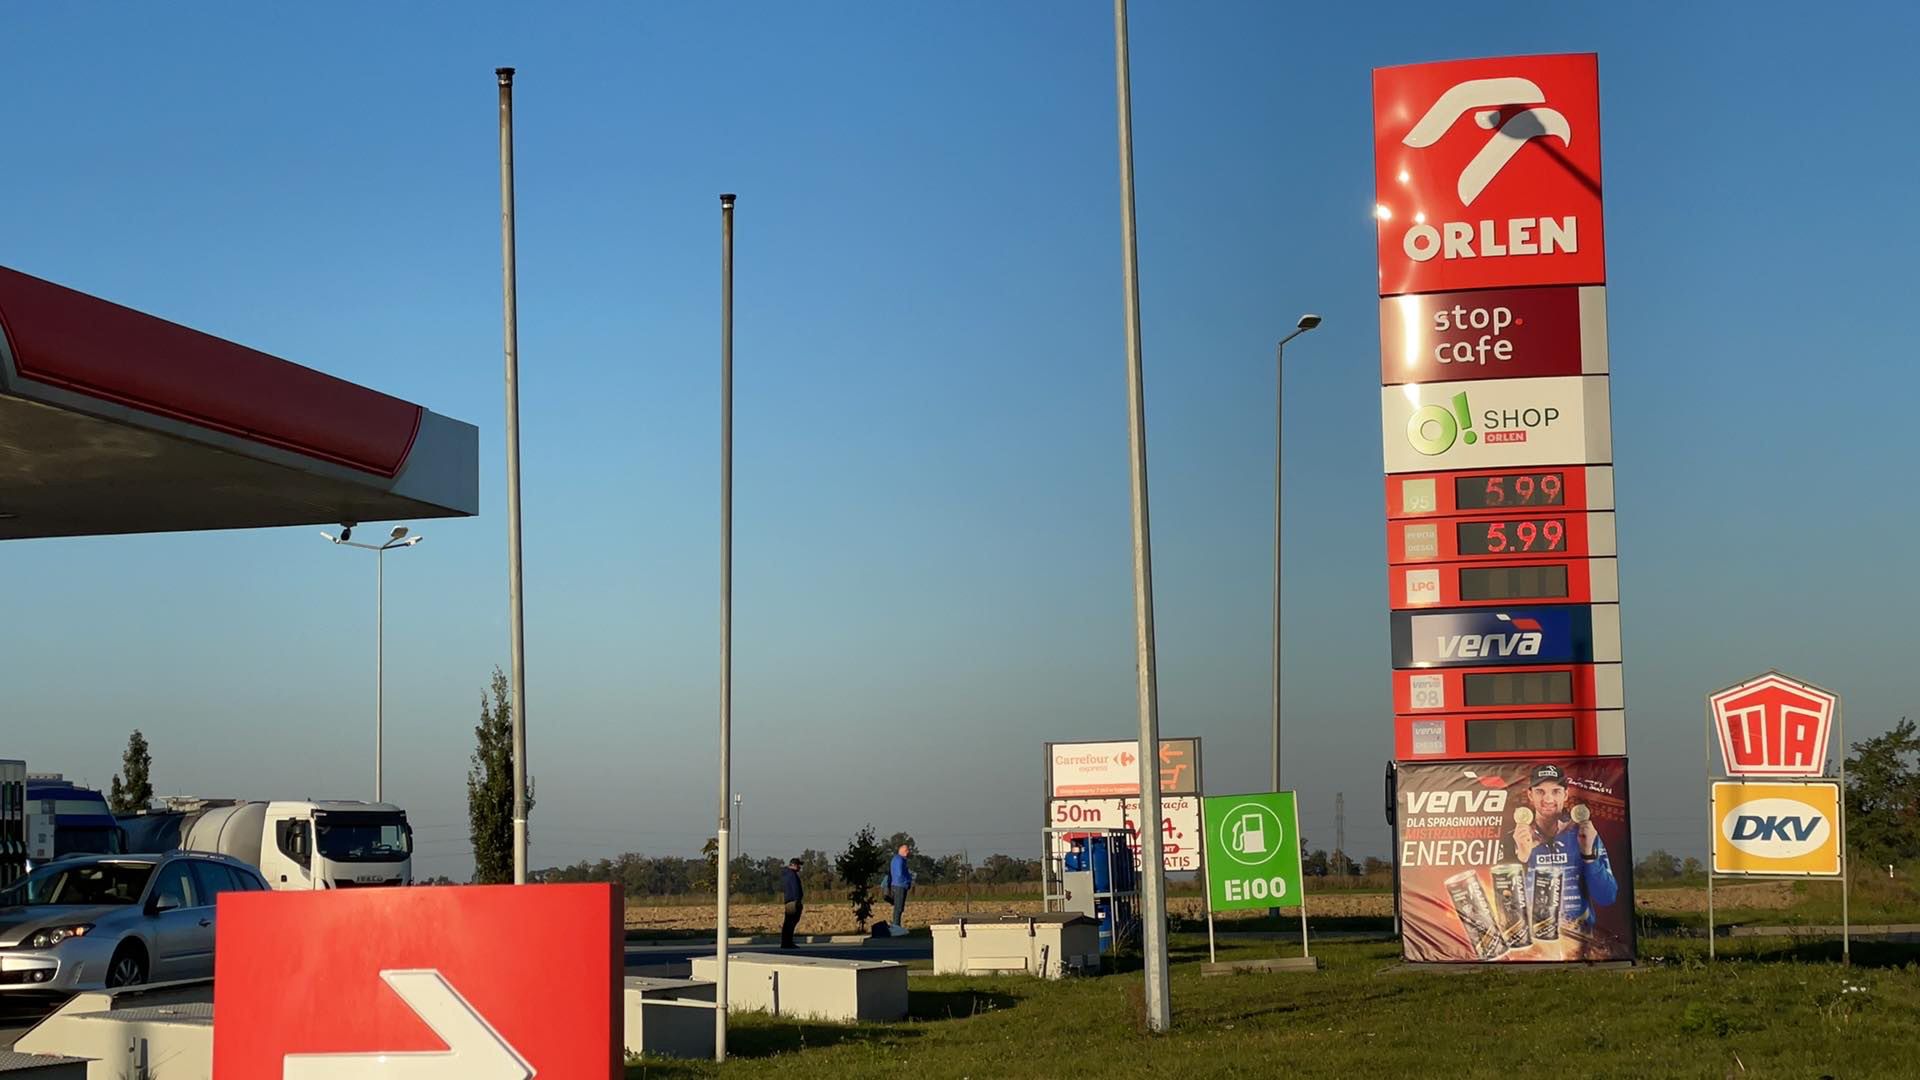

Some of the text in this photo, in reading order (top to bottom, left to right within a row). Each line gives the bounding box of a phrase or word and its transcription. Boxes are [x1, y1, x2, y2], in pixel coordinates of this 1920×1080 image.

[1403, 216, 1577, 262] ORLEN
[1434, 335, 1513, 365] cafe
[1484, 407, 1559, 429] SHOP
[1486, 432, 1525, 443] ORLEN
[1487, 520, 1563, 552] 5.99
[1411, 581, 1435, 592] LPG
[1437, 632, 1543, 658] verva
[1416, 690, 1439, 706] 98
[1724, 686, 1822, 766] UTA
[1055, 753, 1110, 765] Carrefour
[1056, 804, 1101, 823] 50m
[1407, 790, 1508, 814] verva
[1406, 816, 1503, 828] DLA SPRAGNIONYCH
[1731, 815, 1823, 841] DKV
[1401, 839, 1500, 866] ENERGII
[1224, 877, 1286, 901] E100
